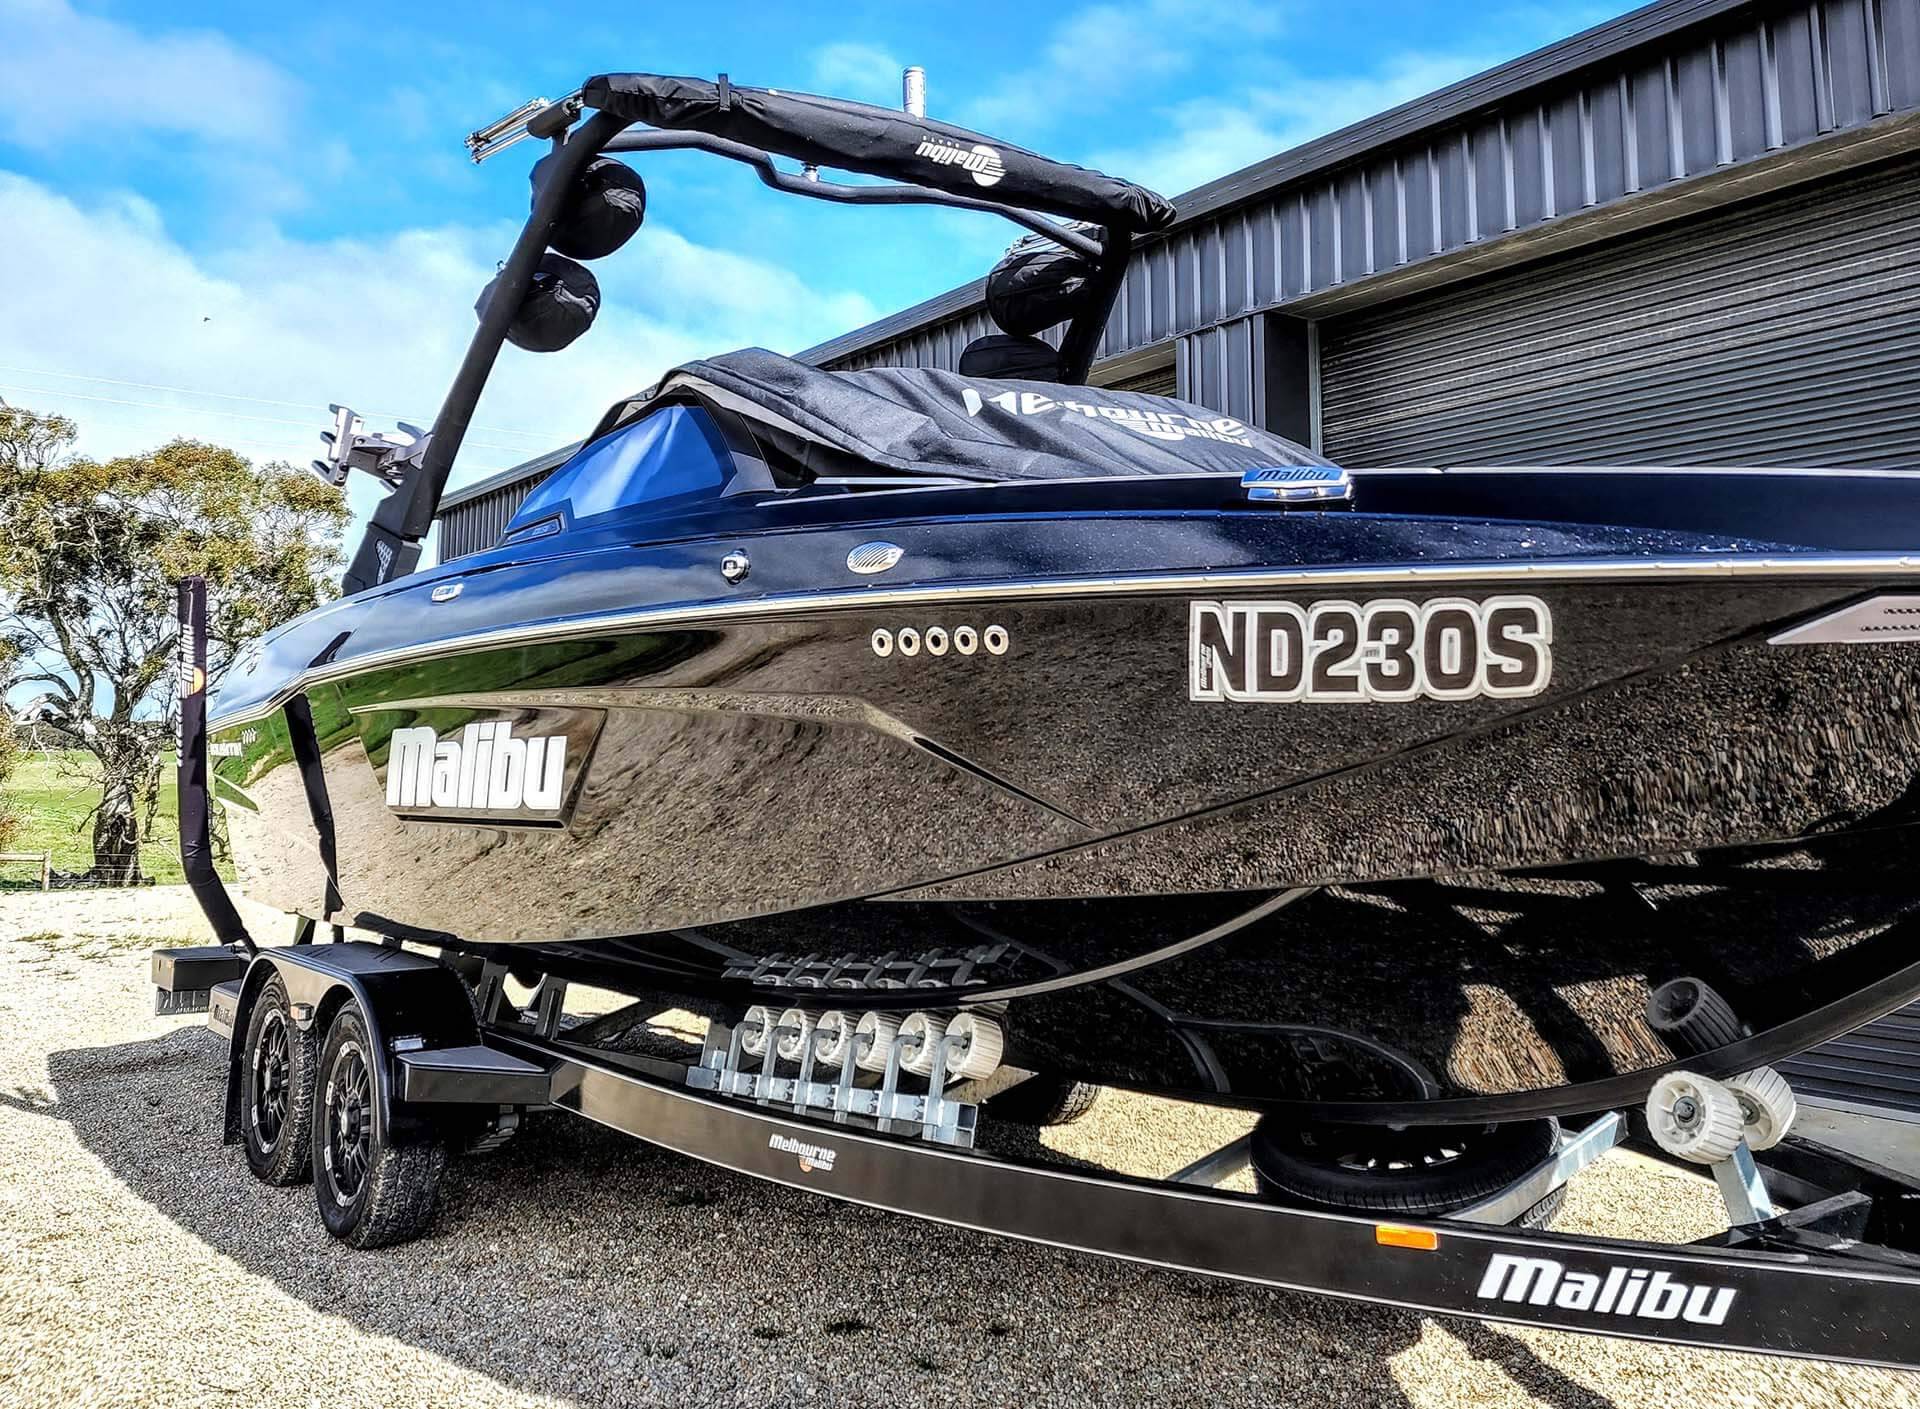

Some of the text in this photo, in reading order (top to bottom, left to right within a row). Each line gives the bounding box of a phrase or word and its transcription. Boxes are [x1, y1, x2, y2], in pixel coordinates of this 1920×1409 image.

[914, 141, 989, 173] Malibu
[1255, 468, 1331, 481] Malibu
[1190, 596, 1553, 703] ND230S
[386, 721, 567, 810] Malibu
[768, 1133, 837, 1162] Melbourne
[1476, 1253, 1737, 1325] Malibu
